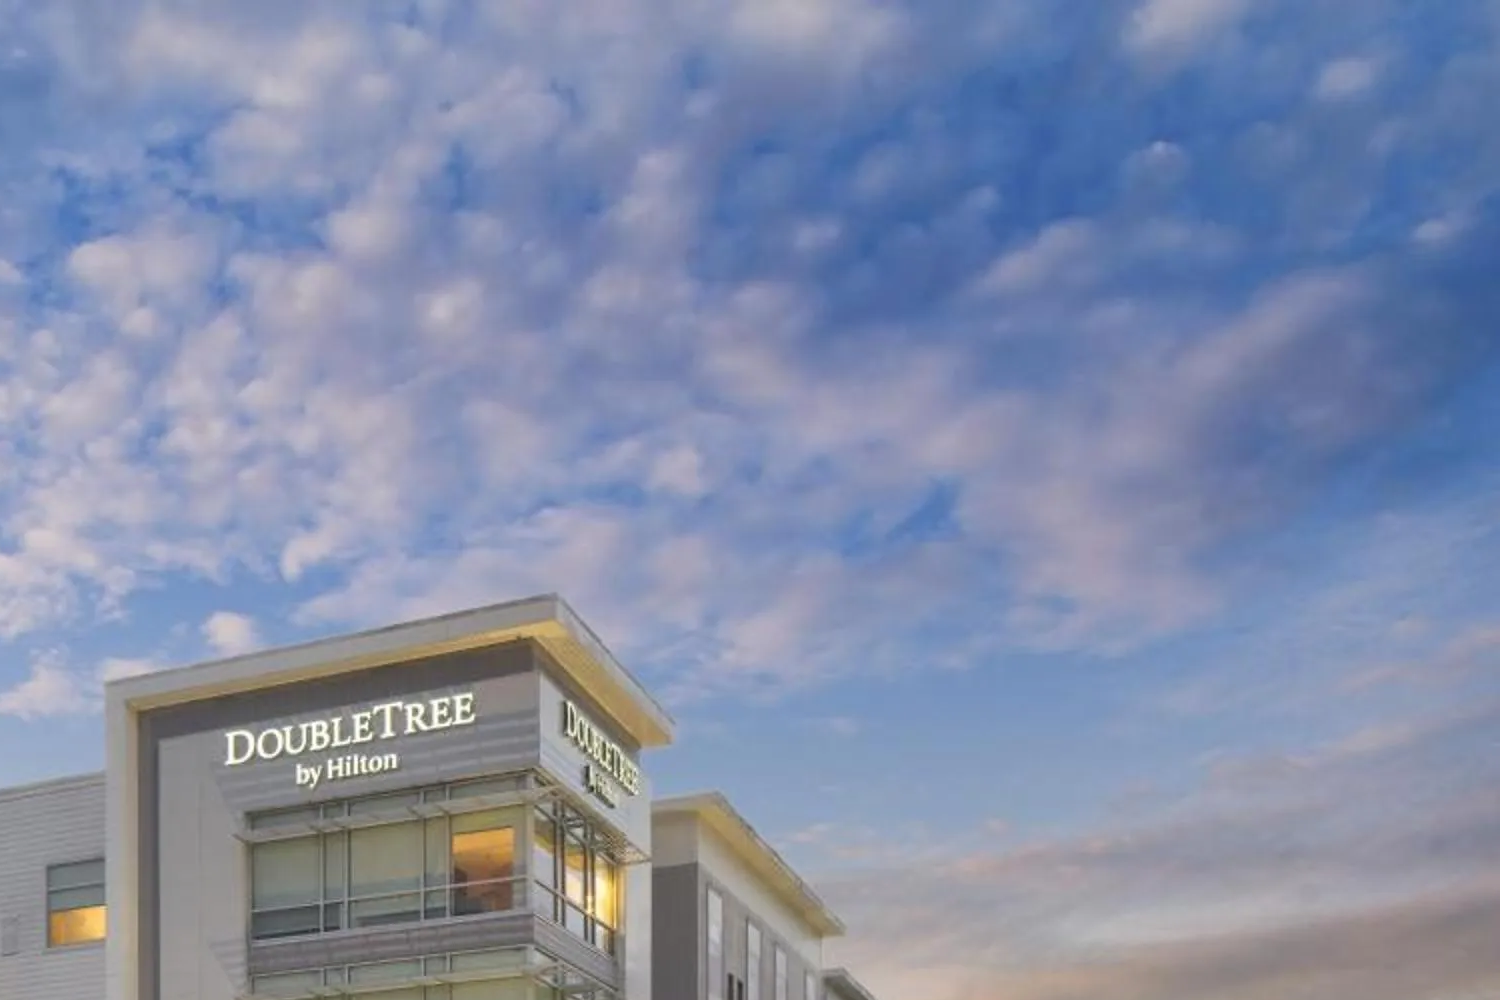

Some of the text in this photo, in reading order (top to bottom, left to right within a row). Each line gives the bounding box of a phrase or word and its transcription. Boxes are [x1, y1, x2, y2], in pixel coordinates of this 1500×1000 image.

[224, 692, 476, 766] DOUBLETREE
[296, 753, 398, 789] by Hilton
